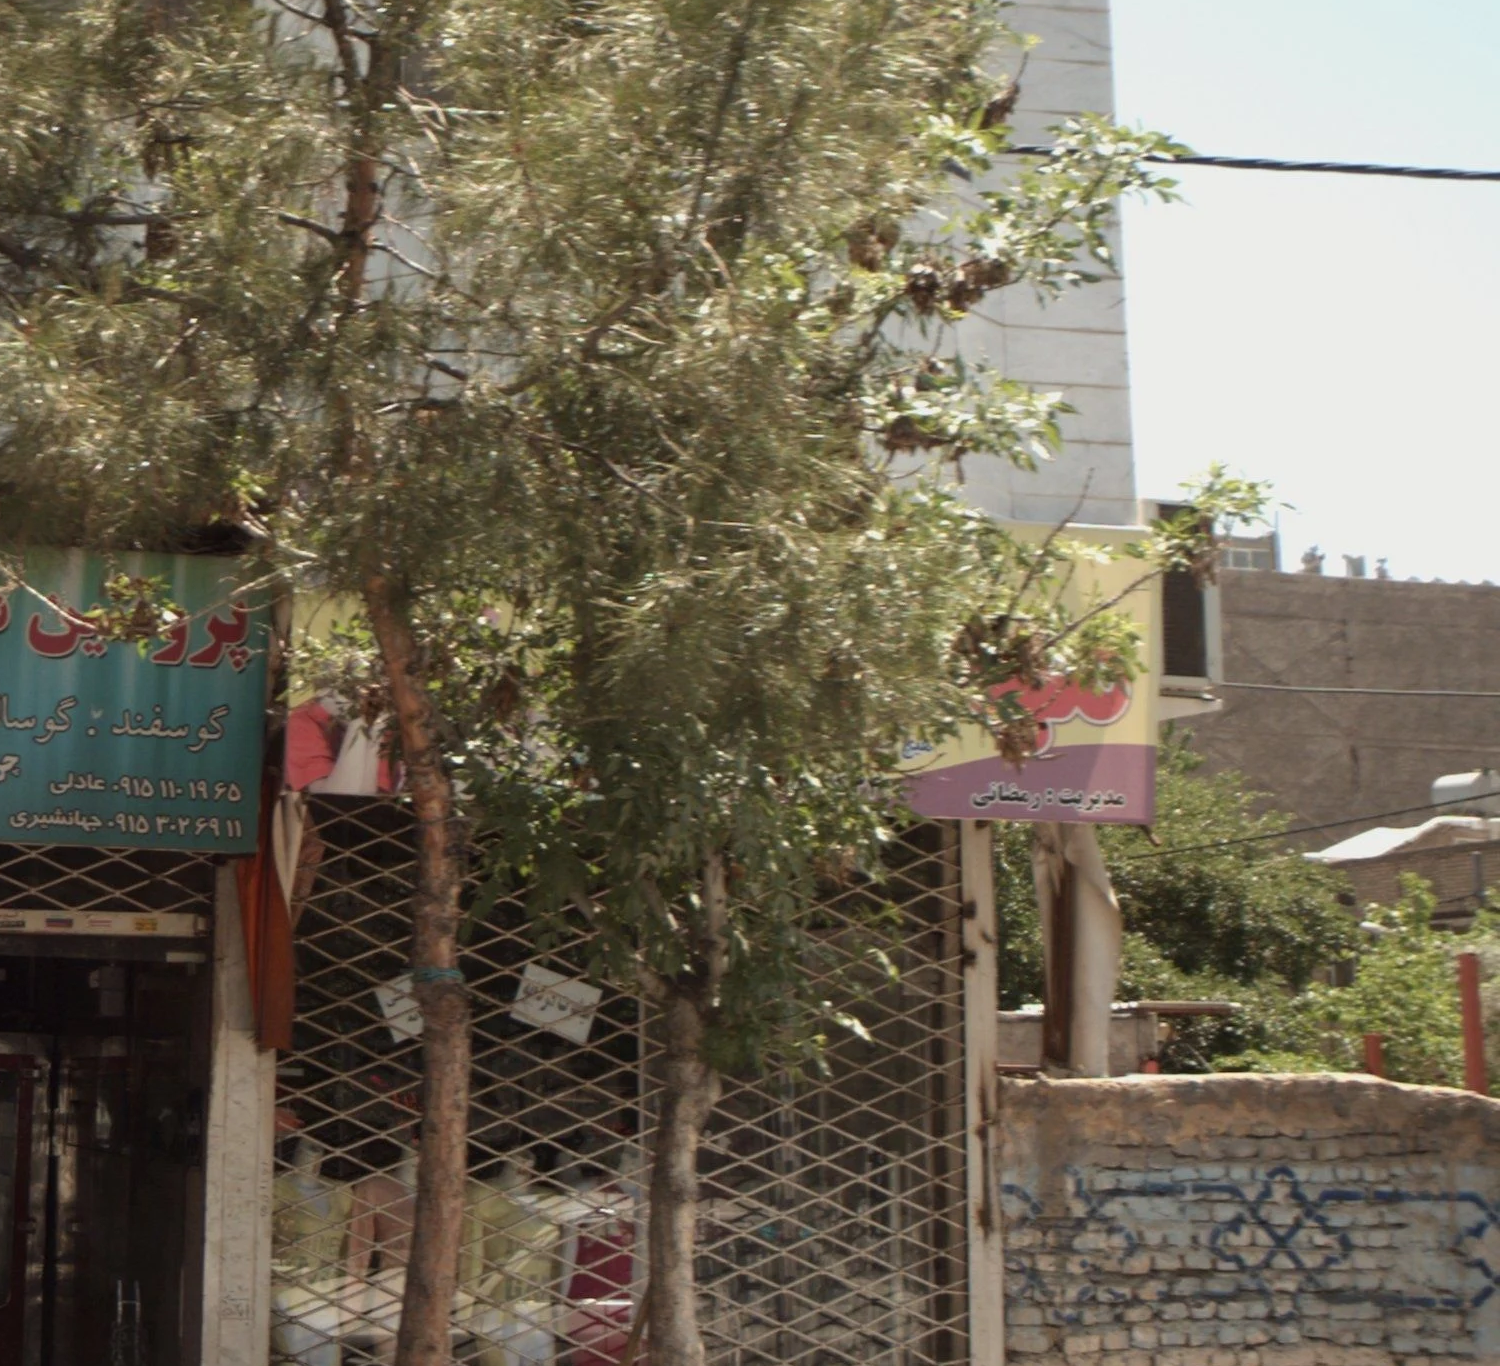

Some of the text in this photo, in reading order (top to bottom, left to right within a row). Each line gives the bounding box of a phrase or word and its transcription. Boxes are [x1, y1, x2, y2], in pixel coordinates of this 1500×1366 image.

[111, 704, 230, 751] گوسفند
[49, 773, 105, 795] عادلی
[970, 781, 1126, 811] مدیریت رمضانی
[9, 807, 103, 832] جهانشیری
